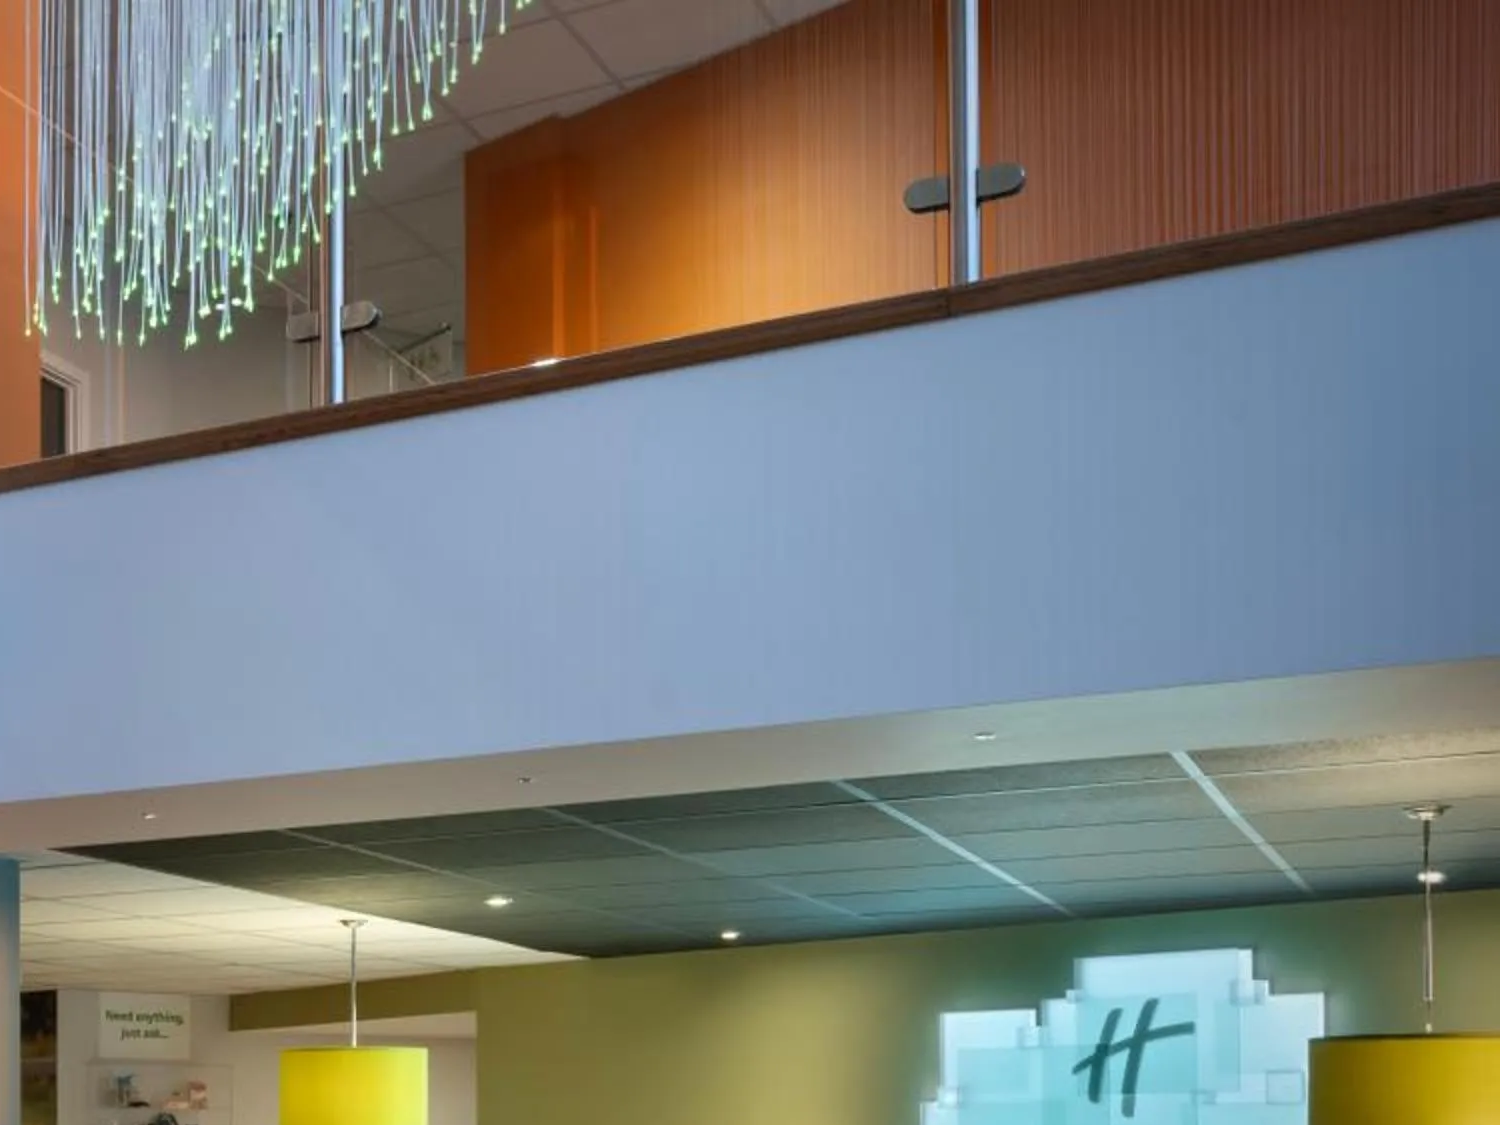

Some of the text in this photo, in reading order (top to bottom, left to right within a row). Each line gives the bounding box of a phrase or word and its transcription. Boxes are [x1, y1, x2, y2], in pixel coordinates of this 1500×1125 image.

[105, 1009, 133, 1022] Need
[120, 1028, 141, 1041] just
[1072, 998, 1195, 1118] H
